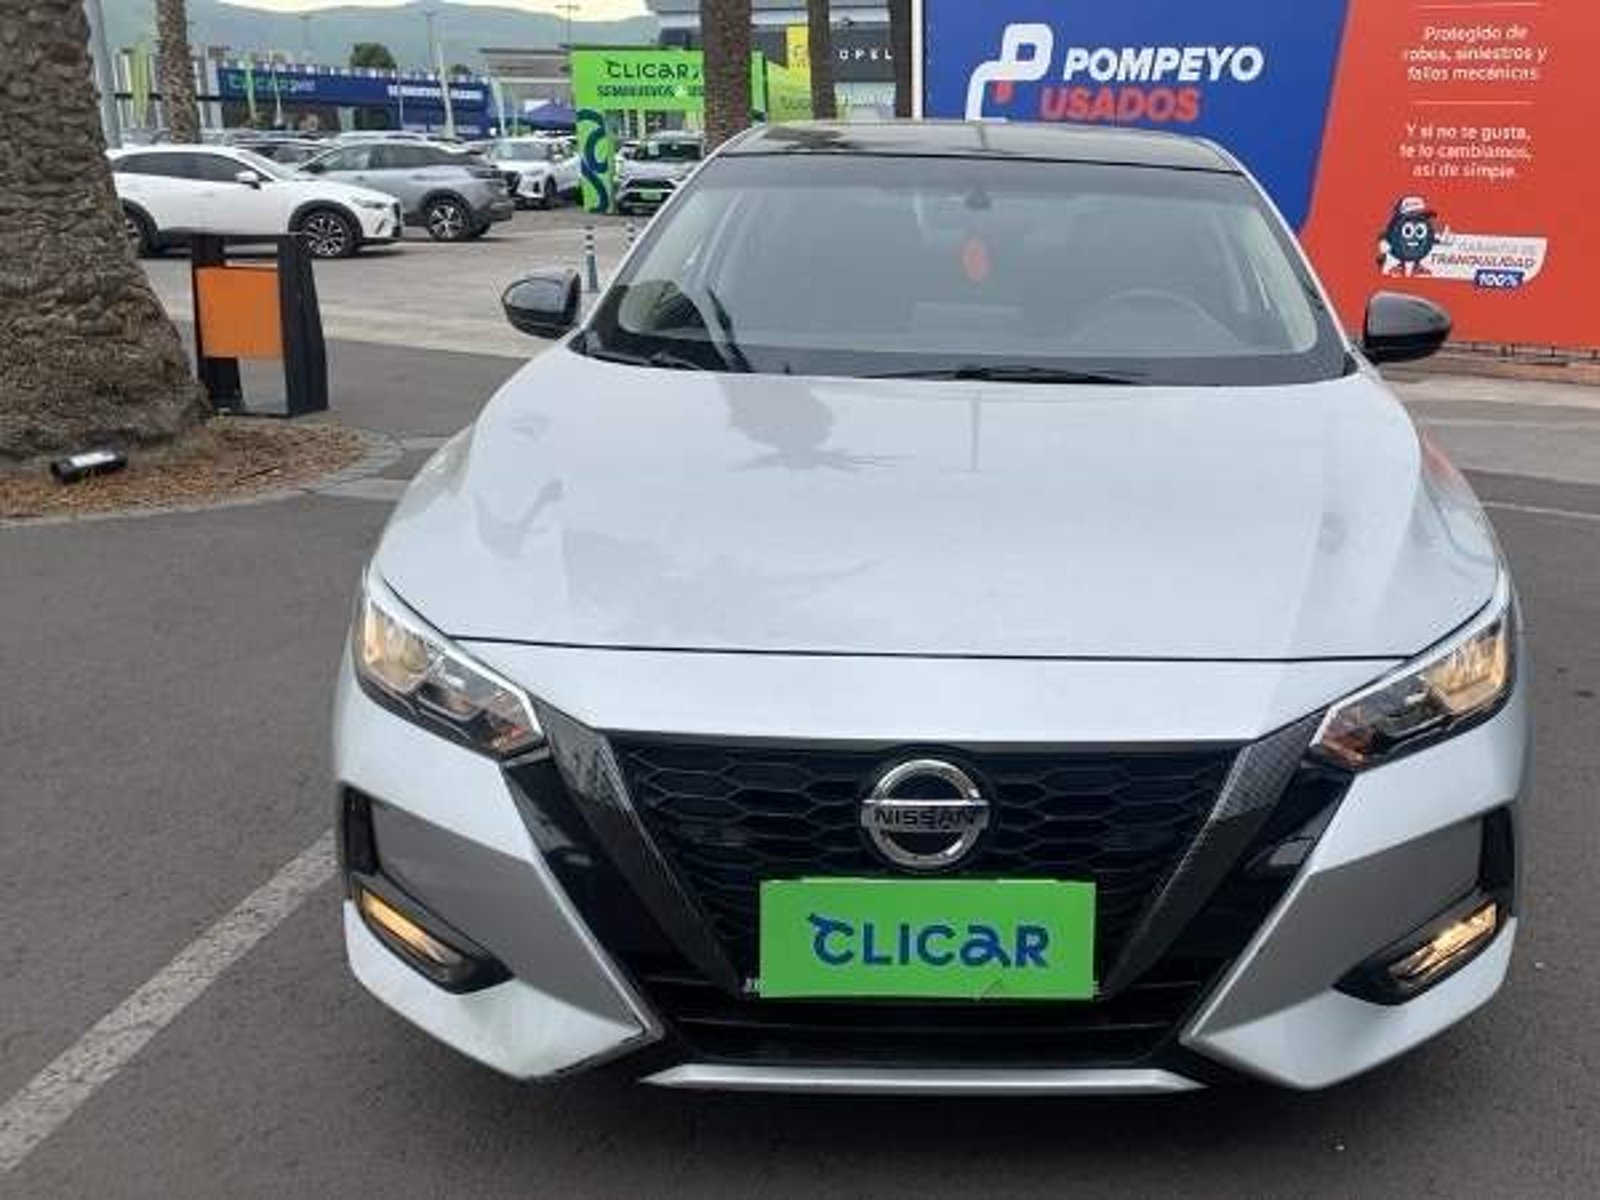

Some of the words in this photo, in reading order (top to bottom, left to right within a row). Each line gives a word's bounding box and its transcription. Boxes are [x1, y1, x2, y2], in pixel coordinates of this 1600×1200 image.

[839, 49, 893, 60] OPEL
[1537, 48, 1549, 63] y
[1063, 47, 1265, 82] POMPEYO
[1040, 86, 1201, 122] USADOS
[1436, 126, 1457, 138] no
[1478, 272, 1520, 287] 100%
[873, 808, 975, 825] NISSAN
